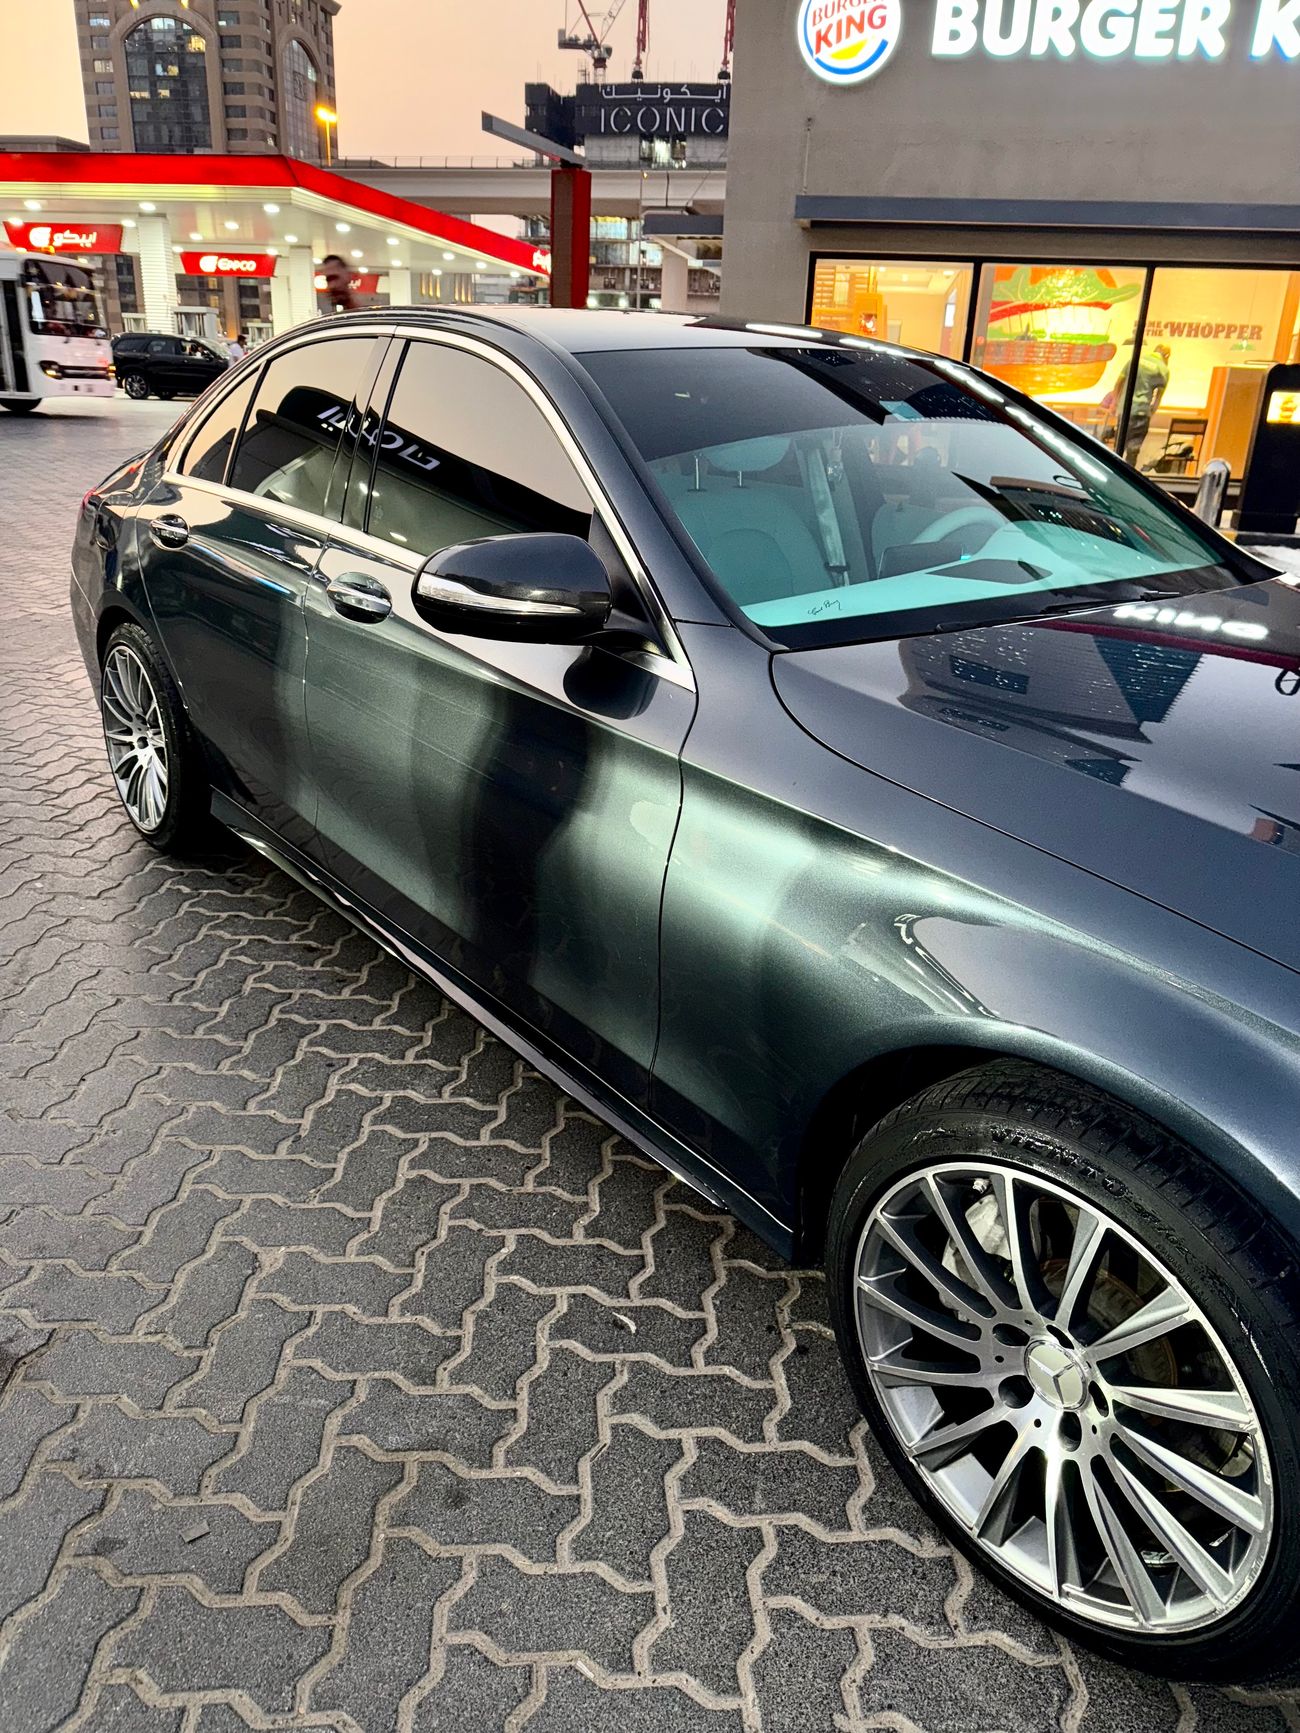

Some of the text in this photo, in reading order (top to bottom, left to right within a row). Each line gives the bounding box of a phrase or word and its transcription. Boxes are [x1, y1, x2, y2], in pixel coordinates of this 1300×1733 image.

[815, 4, 888, 55] KING
[931, 0, 1232, 58] BURGER
[600, 106, 725, 133] ICONIC
[1163, 320, 1263, 340] WHOPPER
